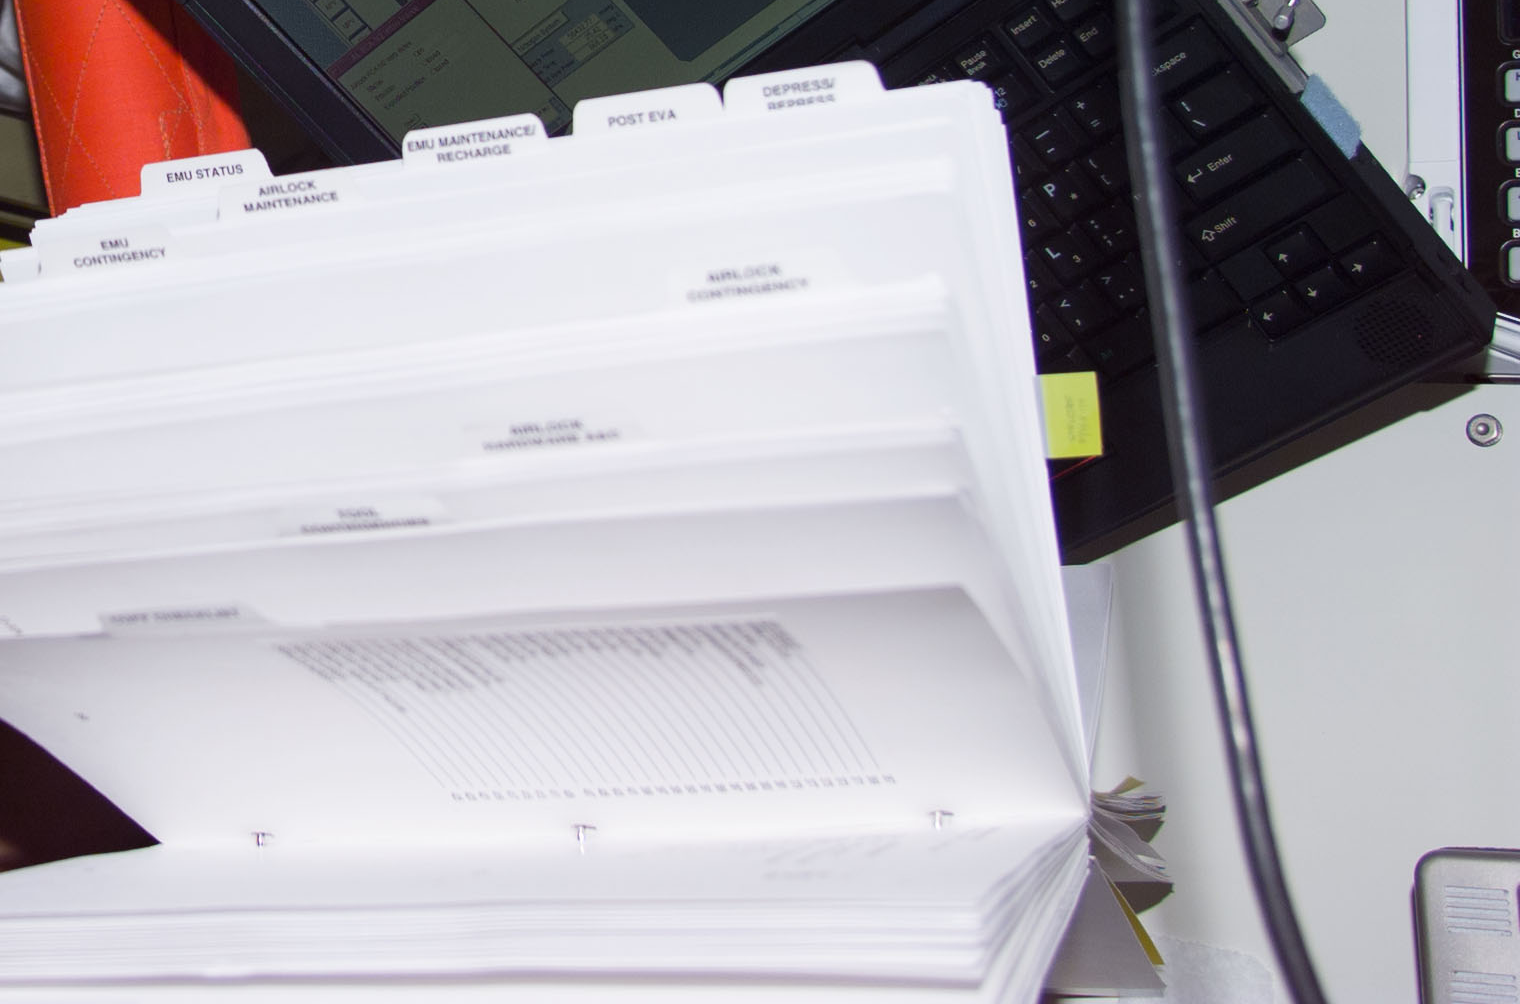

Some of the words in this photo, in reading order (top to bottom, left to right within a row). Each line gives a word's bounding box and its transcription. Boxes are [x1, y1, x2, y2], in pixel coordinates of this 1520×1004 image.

[1011, 15, 1038, 36] Insert
[1079, 27, 1099, 43] End
[960, 49, 987, 69] Pause
[1038, 48, 1066, 69] Delete
[762, 77, 835, 97] DEPRESS/
[995, 87, 1006, 98] 12
[607, 113, 644, 128] POST
[648, 109, 677, 124] EVA
[407, 137, 435, 153] EMU
[438, 124, 536, 149] MAINTENANCE/
[437, 143, 512, 163] RECHARGE
[1207, 154, 1233, 173] Enter
[166, 171, 193, 184] EMU
[195, 164, 244, 180] STATUS
[258, 180, 317, 197] AIRLOCK
[1043, 183, 1056, 197] P
[243, 191, 340, 214] MAINTENANCE
[1213, 216, 1237, 234] Shift
[100, 238, 130, 252] EMU
[1045, 247, 1061, 260] L
[73, 248, 166, 268] CONTINGENCY
